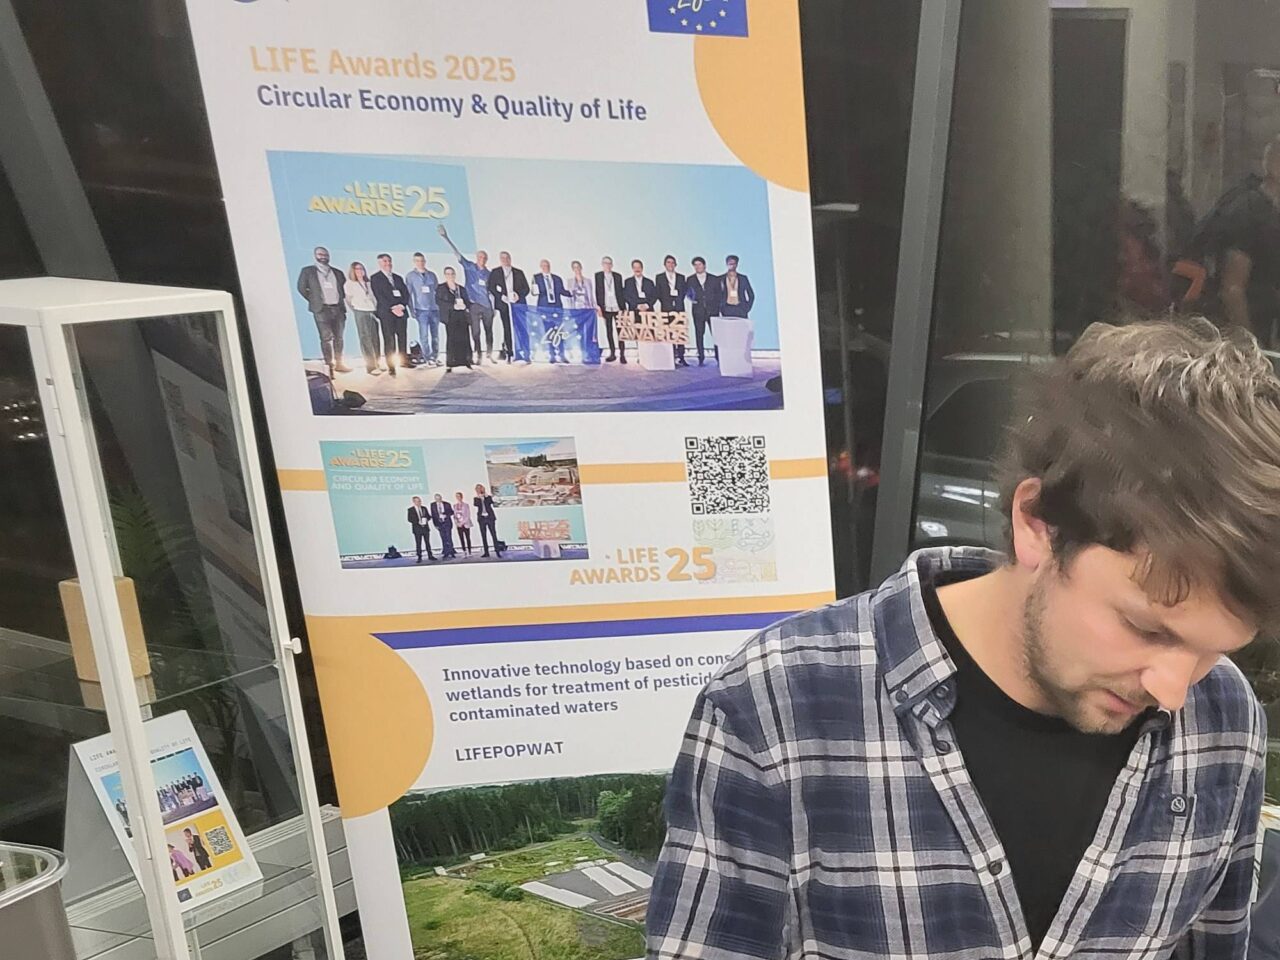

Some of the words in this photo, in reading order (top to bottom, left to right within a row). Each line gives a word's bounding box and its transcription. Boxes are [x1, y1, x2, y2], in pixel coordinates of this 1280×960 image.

[250, 46, 319, 74] LIFE
[329, 49, 437, 79] Awards
[445, 55, 516, 82] 2025
[257, 84, 352, 109] Circular
[358, 89, 464, 118] Economy
[471, 94, 487, 114] &
[494, 95, 574, 122] Quality
[580, 98, 601, 119] of
[607, 99, 647, 120] Life
[308, 195, 405, 217] AWARDS
[405, 185, 450, 219] 25
[354, 181, 403, 199] LIFE
[569, 565, 661, 585] AWARDS
[665, 546, 717, 582] 25
[616, 547, 659, 564] LIFE
[442, 663, 531, 682] Innovative
[534, 658, 621, 676] technology
[625, 654, 671, 670] based
[675, 656, 694, 667] on
[697, 654, 732, 666] cons
[446, 684, 521, 702] wetlands
[525, 683, 548, 697] for
[551, 678, 631, 695] treatment
[634, 676, 649, 690] of
[653, 672, 713, 692] pesticid
[449, 701, 561, 722] contaminated
[564, 700, 618, 714] waters
[455, 741, 564, 761] LIFEPOPWAT
